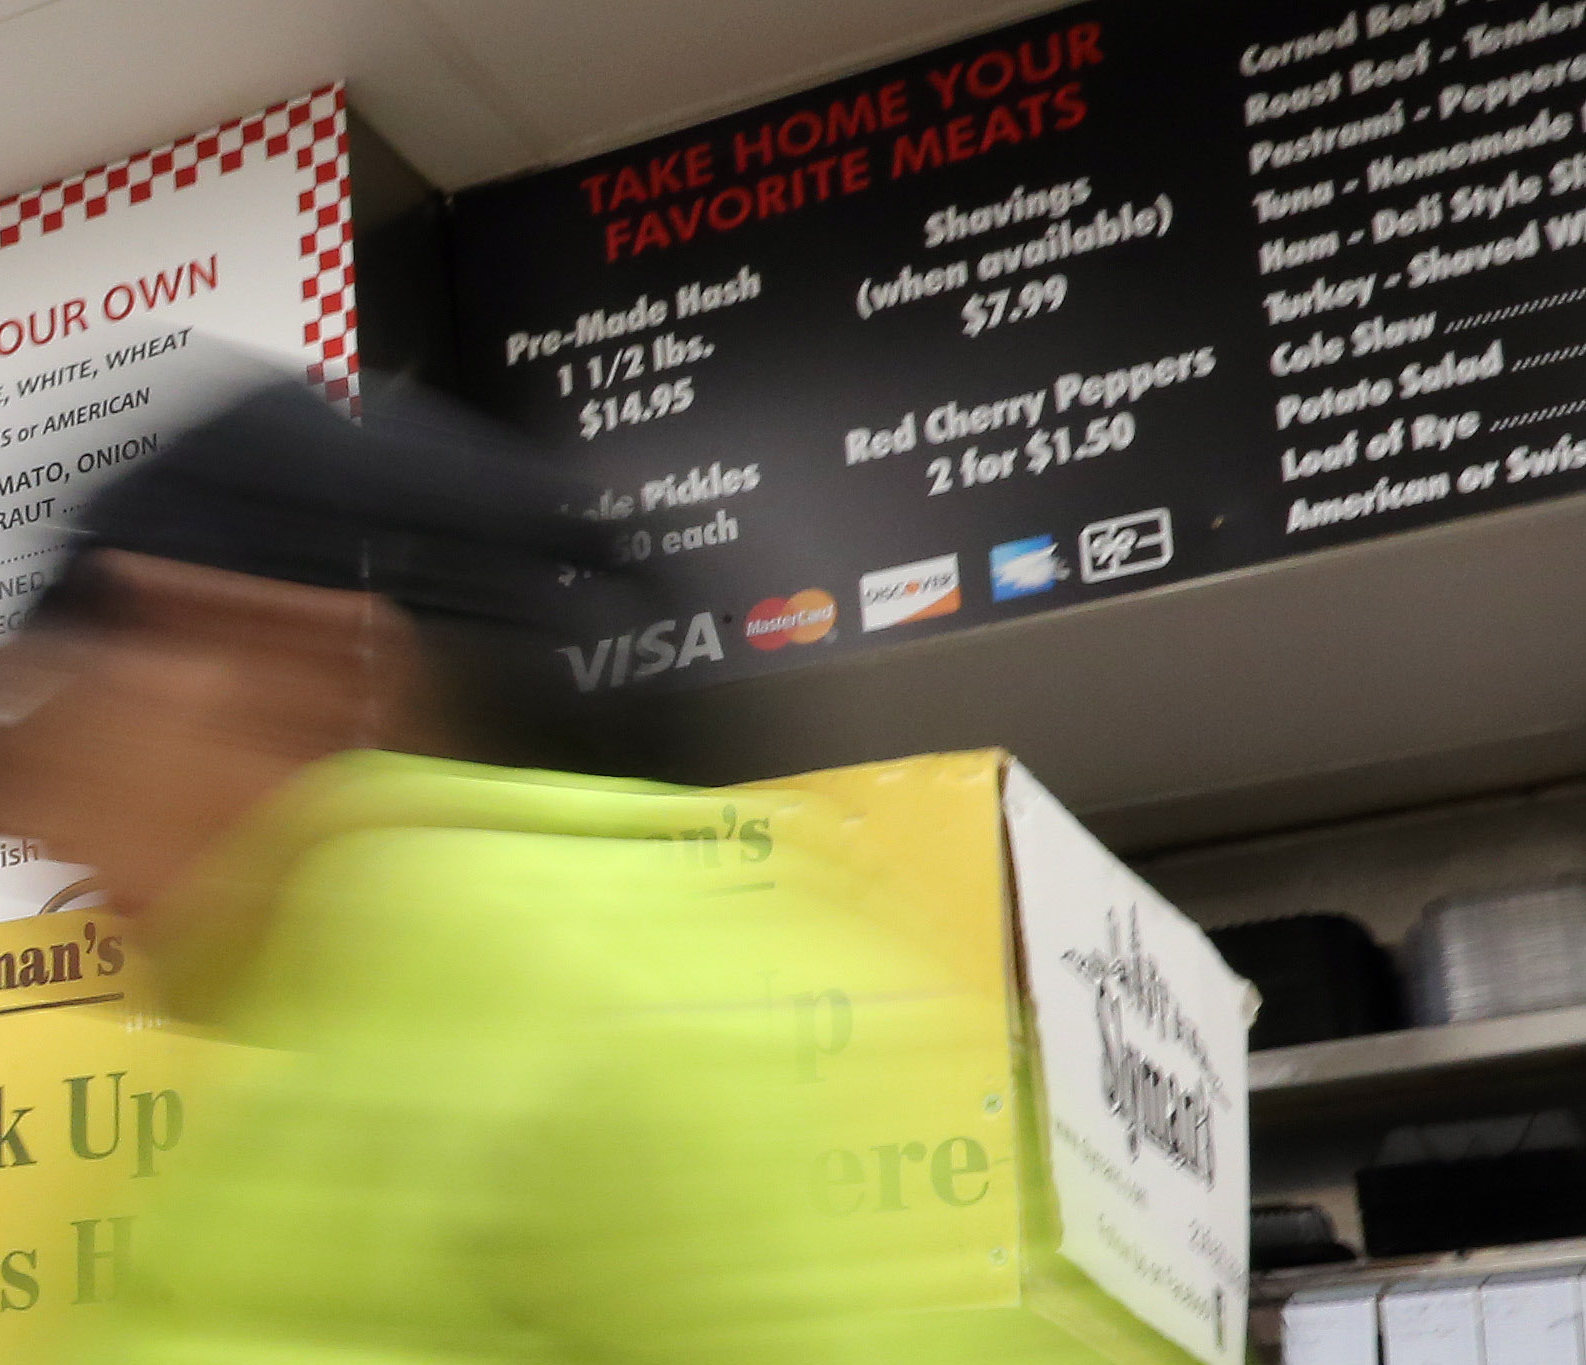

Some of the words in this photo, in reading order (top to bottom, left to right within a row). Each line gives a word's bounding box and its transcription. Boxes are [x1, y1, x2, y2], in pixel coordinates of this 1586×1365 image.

[1240, 12, 1358, 77] Corned
[1245, 72, 1342, 127] Roast
[1349, 39, 1430, 95] Beef
[581, 143, 712, 216] TAKE
[734, 85, 908, 170] HOME
[930, 27, 1104, 111] YOUR
[1249, 100, 1406, 175] Pastrami
[605, 152, 870, 262] FAVORITE
[892, 90, 1087, 180] MEATS
[1253, 181, 1334, 223] Tuna
[1366, 108, 1573, 192] Homemade
[926, 175, 1090, 247] Shavings
[1260, 231, 1339, 275] Ham
[1372, 192, 1443, 244] Deli
[1451, 171, 1541, 223] Style
[103, 257, 220, 322] OWN
[858, 259, 967, 320] (when
[978, 194, 1173, 281] available)
[1264, 273, 1376, 326] Turkey
[1408, 219, 1539, 288] Shaved
[508, 286, 667, 364] Pre-Made
[677, 267, 760, 318] Hash
[961, 274, 1067, 338] $7.99
[18, 356, 99, 395] WHITE,
[105, 326, 192, 368] WHEAT
[589, 347, 645, 389] 1/2
[653, 334, 714, 376] lbs.
[1271, 331, 1345, 377] Cole
[1350, 311, 1436, 357] Slaw
[17, 423, 37, 441] or
[43, 386, 150, 433] AMERICAN
[580, 377, 695, 441] $14.95
[846, 414, 914, 467] Red
[926, 389, 1046, 444] Cherry
[1056, 345, 1217, 416] Peppers
[1277, 377, 1393, 431] Potato
[1399, 339, 1503, 398] Salad
[78, 435, 157, 472] ONION
[928, 459, 952, 497] 2
[959, 442, 1014, 489] for
[1027, 412, 1134, 473] $1.50
[1282, 430, 1359, 483] Loaf
[1366, 418, 1404, 454] of
[1411, 410, 1480, 451] Rye
[644, 461, 760, 511] Pickles
[1286, 472, 1450, 534] American
[1457, 459, 1500, 492] or
[662, 511, 739, 561] each
[556, 611, 725, 692] VISA
[745, 603, 834, 637] MasterCard
[63, 1072, 185, 1180] Up
